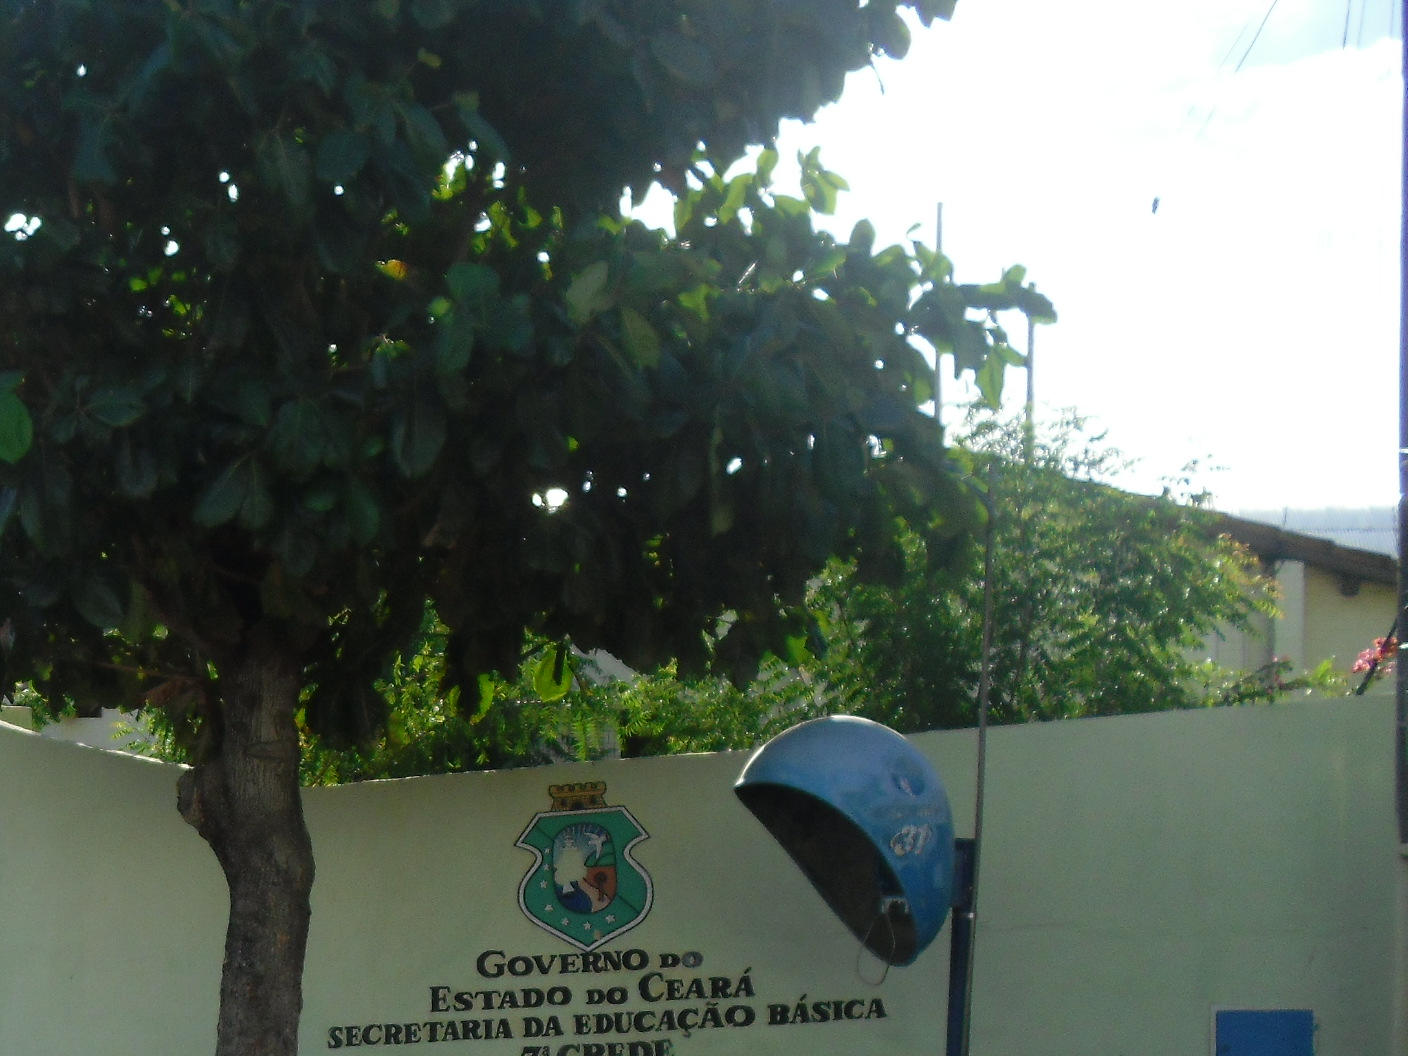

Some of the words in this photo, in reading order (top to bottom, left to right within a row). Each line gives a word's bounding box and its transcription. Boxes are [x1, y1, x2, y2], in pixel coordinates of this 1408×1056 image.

[476, 949, 650, 978] GOVERNO
[659, 951, 704, 969] DO
[429, 985, 573, 1013] ESTADO
[586, 986, 629, 1005] DO
[638, 966, 756, 1003] CEARÁ
[327, 1017, 514, 1049] SECRETARIA
[522, 1015, 564, 1038] DA
[573, 1001, 756, 1038] EDUCAÇÃO
[767, 993, 888, 1026] BÁSICA
